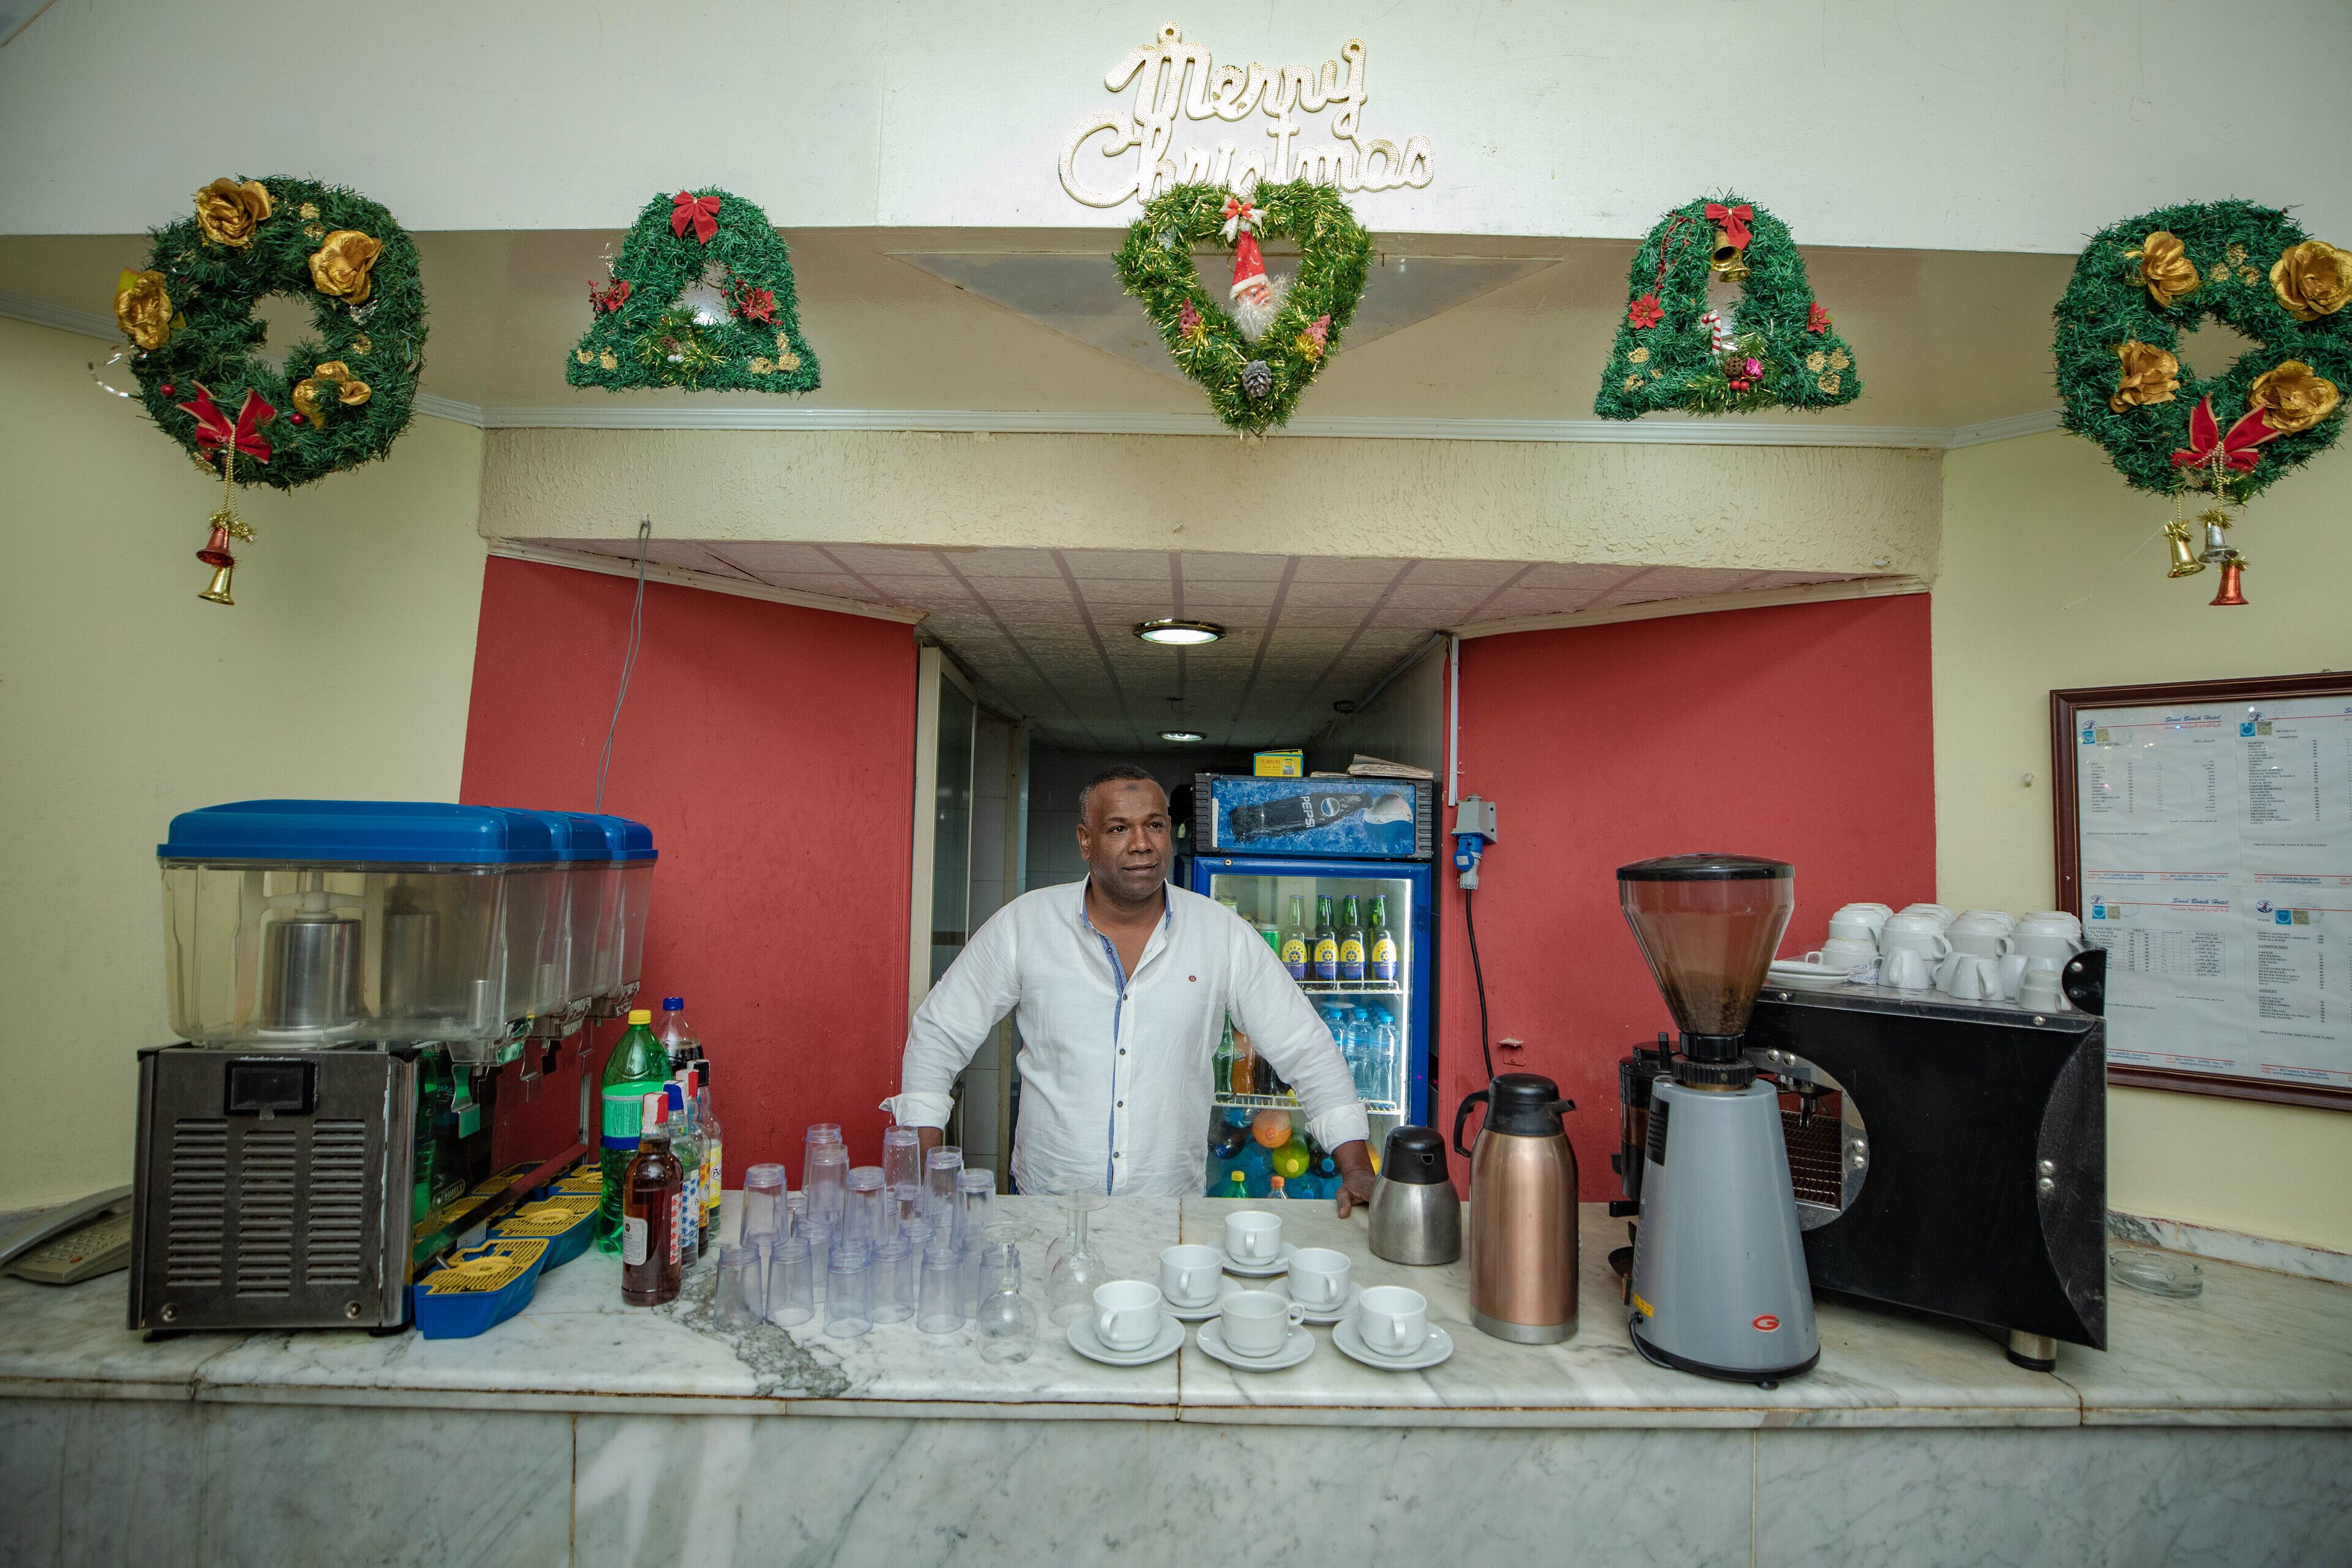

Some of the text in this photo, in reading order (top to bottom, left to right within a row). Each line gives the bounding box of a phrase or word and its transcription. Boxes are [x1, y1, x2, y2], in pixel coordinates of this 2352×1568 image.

[1104, 21, 1368, 140] Merry
[1058, 108, 1434, 208] Christmas
[1299, 796, 1316, 827] PEPSI
